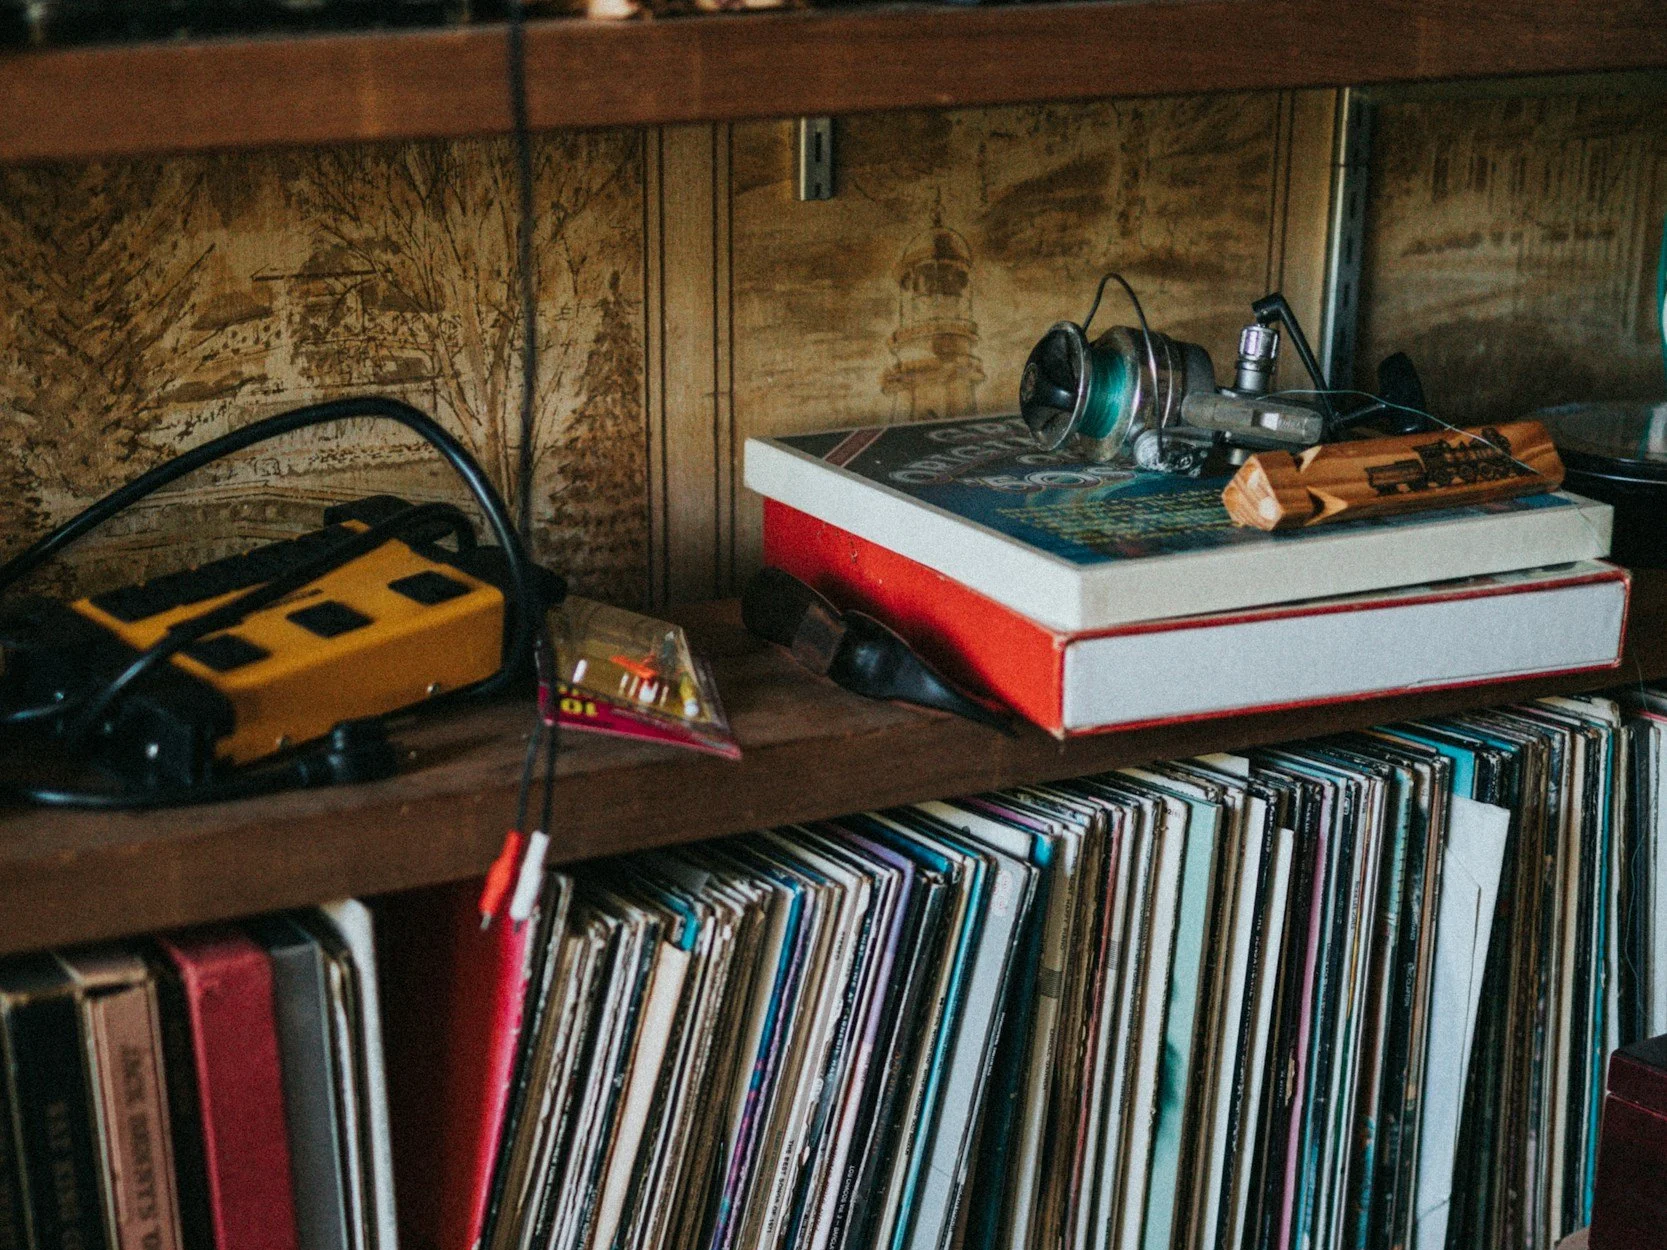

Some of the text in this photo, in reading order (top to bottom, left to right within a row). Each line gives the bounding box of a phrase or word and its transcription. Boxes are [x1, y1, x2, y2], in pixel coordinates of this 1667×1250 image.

[1067, 873, 1076, 895] MOST
[863, 917, 872, 929] AL
[1063, 898, 1072, 923] HAPPY
[834, 930, 846, 961] STEREO
[1059, 927, 1068, 950] PIANO
[845, 991, 854, 1004] AT
[1402, 979, 1411, 1007] CLAPTON
[833, 1006, 850, 1054] CARNEGIE
[121, 1044, 147, 1105] JACK
[826, 1058, 838, 1082] HALL
[846, 1163, 855, 1178] LOS
[52, 1157, 80, 1221] KING
[765, 1139, 794, 1234] THE BEST SONGS OF 1971
[840, 1177, 852, 1203] CHACOS
[583, 1188, 597, 1222] SATURDAY
[578, 1221, 589, 1245] NIGHT
